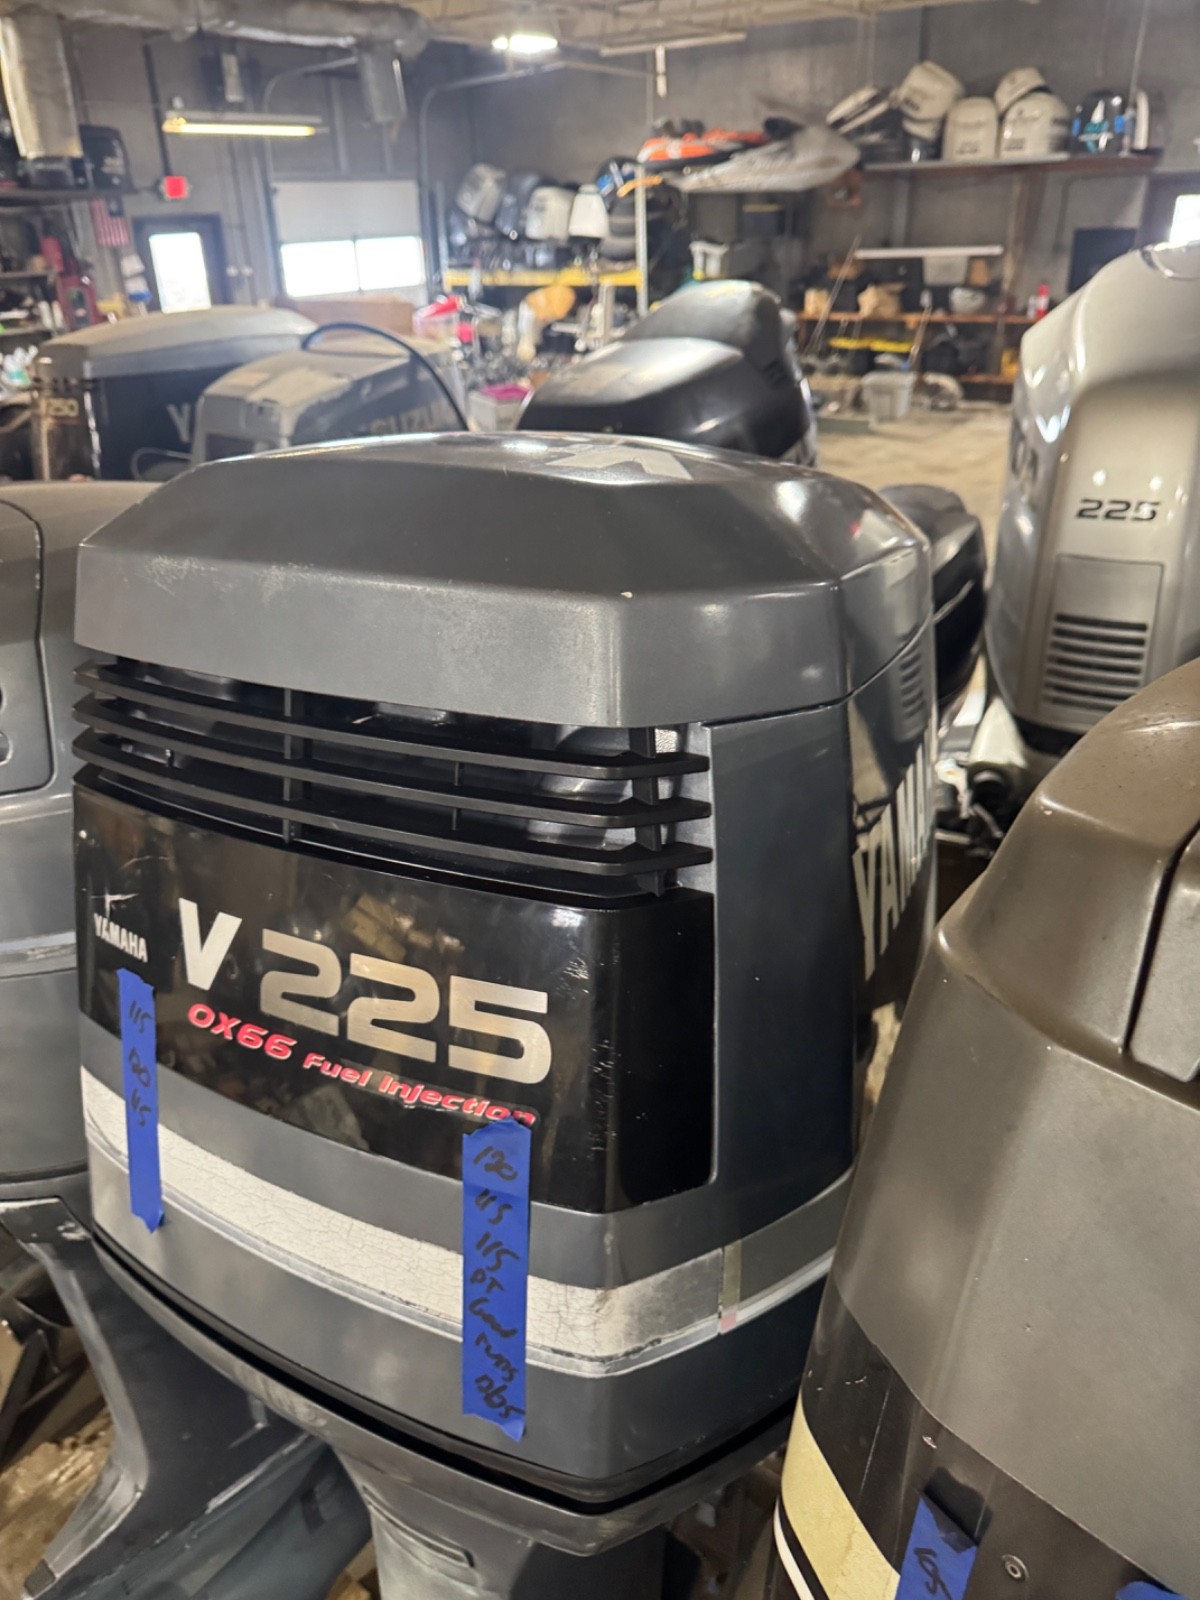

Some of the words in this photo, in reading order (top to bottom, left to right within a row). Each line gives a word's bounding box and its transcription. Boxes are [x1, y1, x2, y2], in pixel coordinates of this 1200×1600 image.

[1076, 498, 1160, 521] 225
[94, 912, 149, 963] YAMAHA
[179, 897, 242, 991] V
[260, 928, 552, 1084] 225
[187, 1003, 298, 1060] OX66
[303, 1052, 371, 1088] Fuel
[378, 1074, 537, 1127] Injection
[472, 1145, 518, 1181] 120
[476, 1231, 520, 1272] 115
